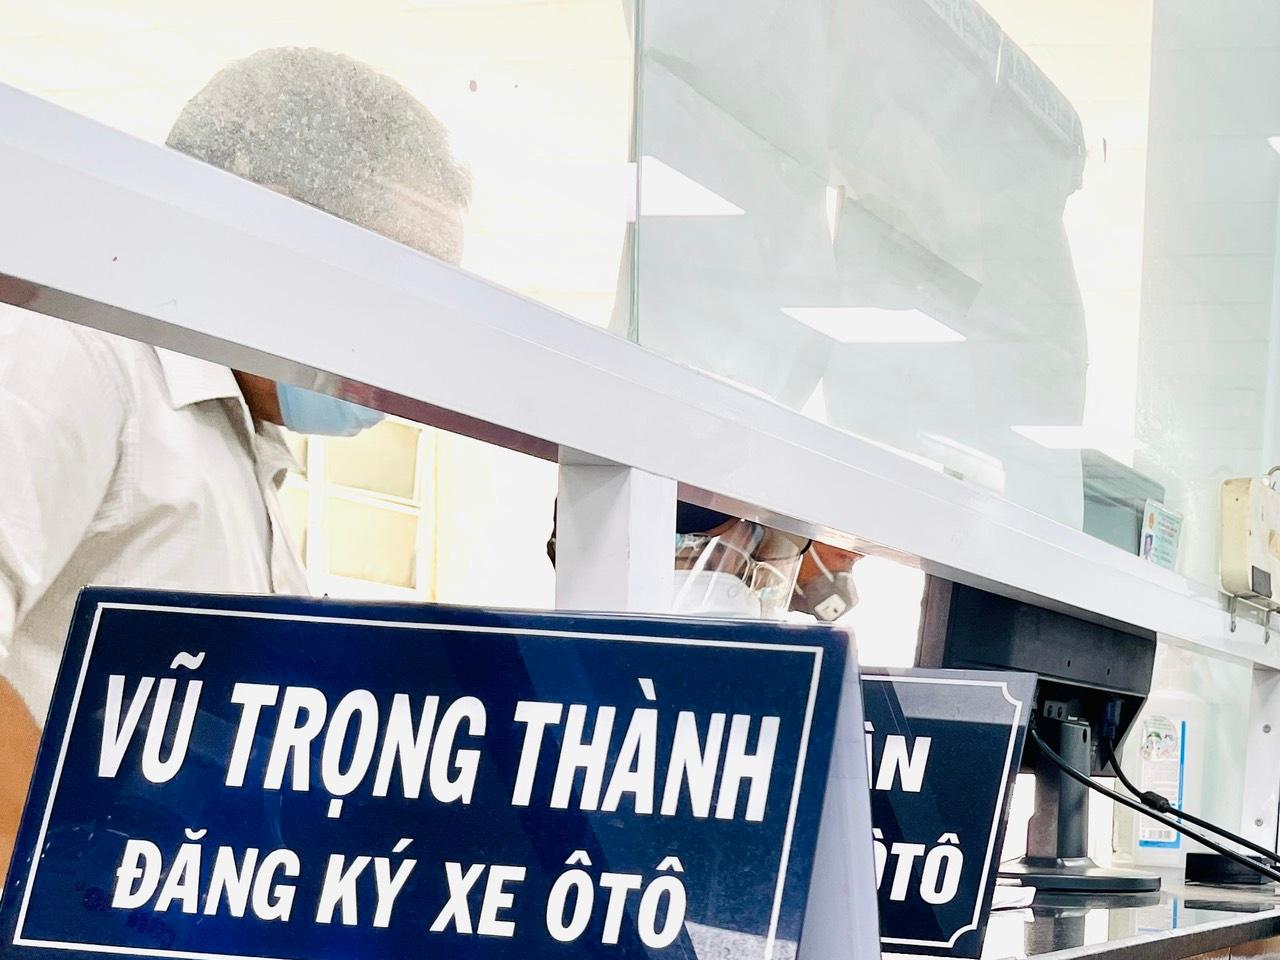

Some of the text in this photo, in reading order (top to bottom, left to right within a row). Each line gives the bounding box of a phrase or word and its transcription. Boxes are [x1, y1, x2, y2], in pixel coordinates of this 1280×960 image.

[99, 652, 780, 822] VŨ TRỌNG THÀNH
[112, 828, 687, 949] ĐĂNG KÝ XE ÔTÔ
